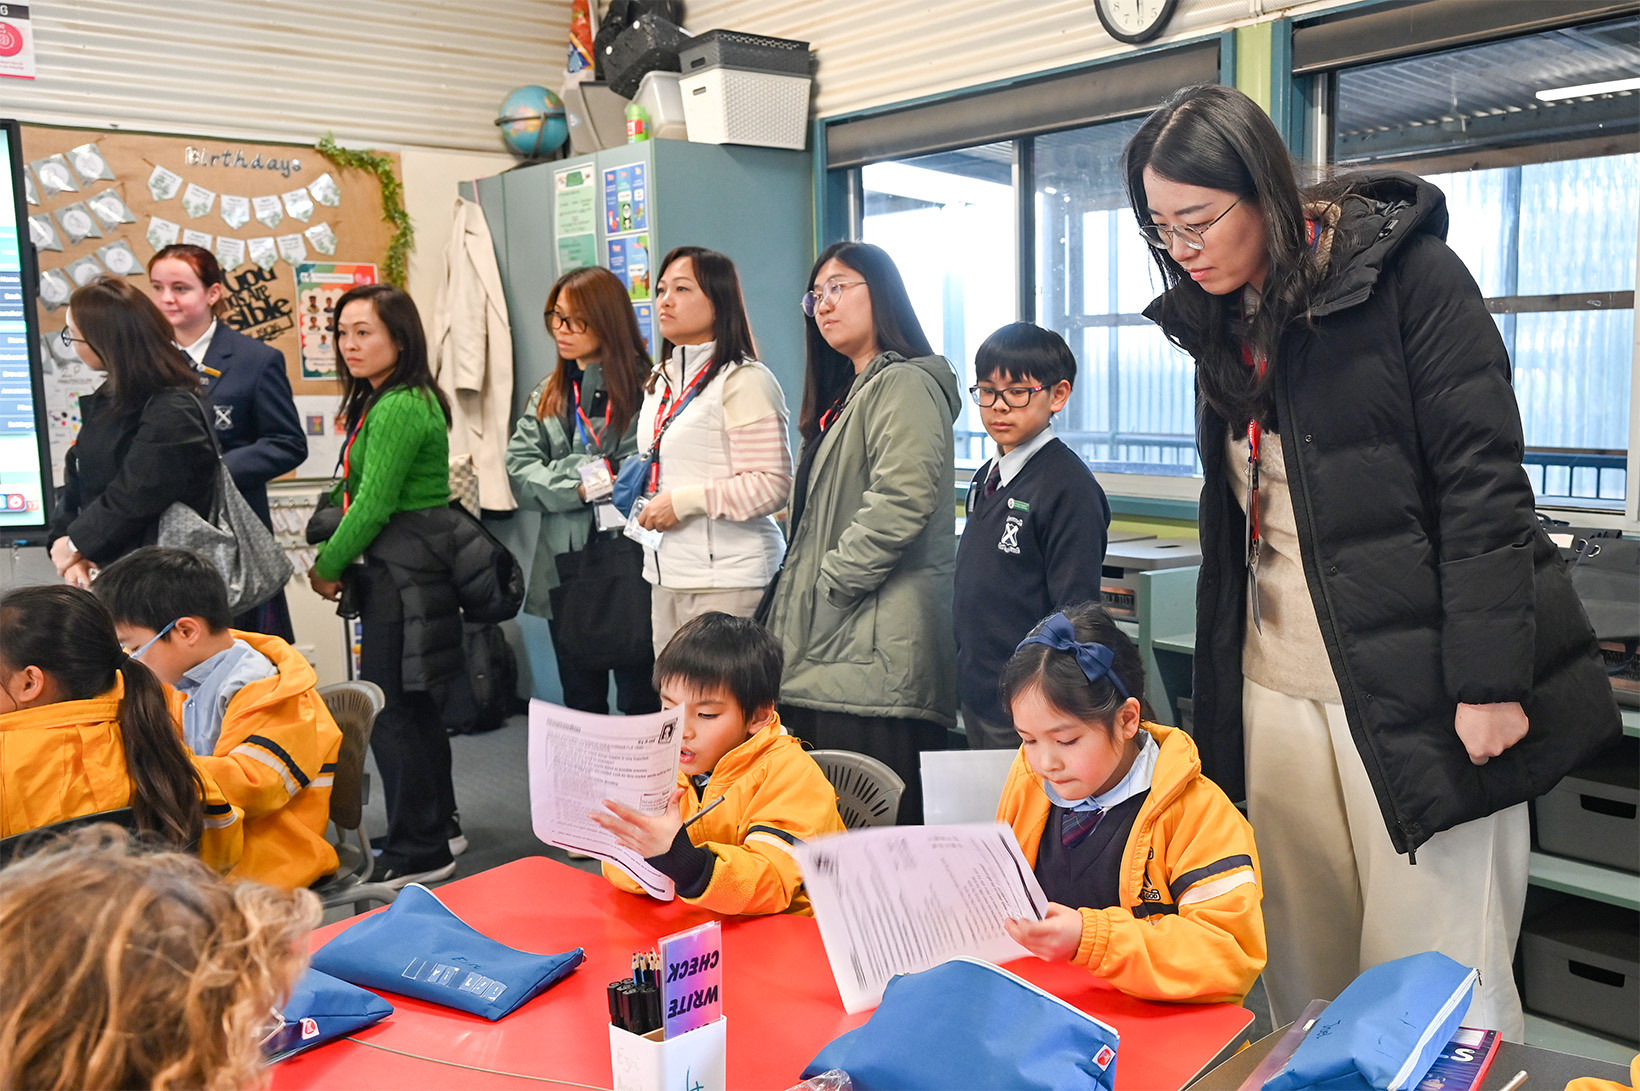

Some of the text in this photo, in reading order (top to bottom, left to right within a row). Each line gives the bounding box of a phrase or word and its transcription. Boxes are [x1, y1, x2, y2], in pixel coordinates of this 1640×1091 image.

[185, 146, 301, 178] Birthdays
[666, 949, 720, 984] CHECK
[667, 984, 718, 1019] WRITE
